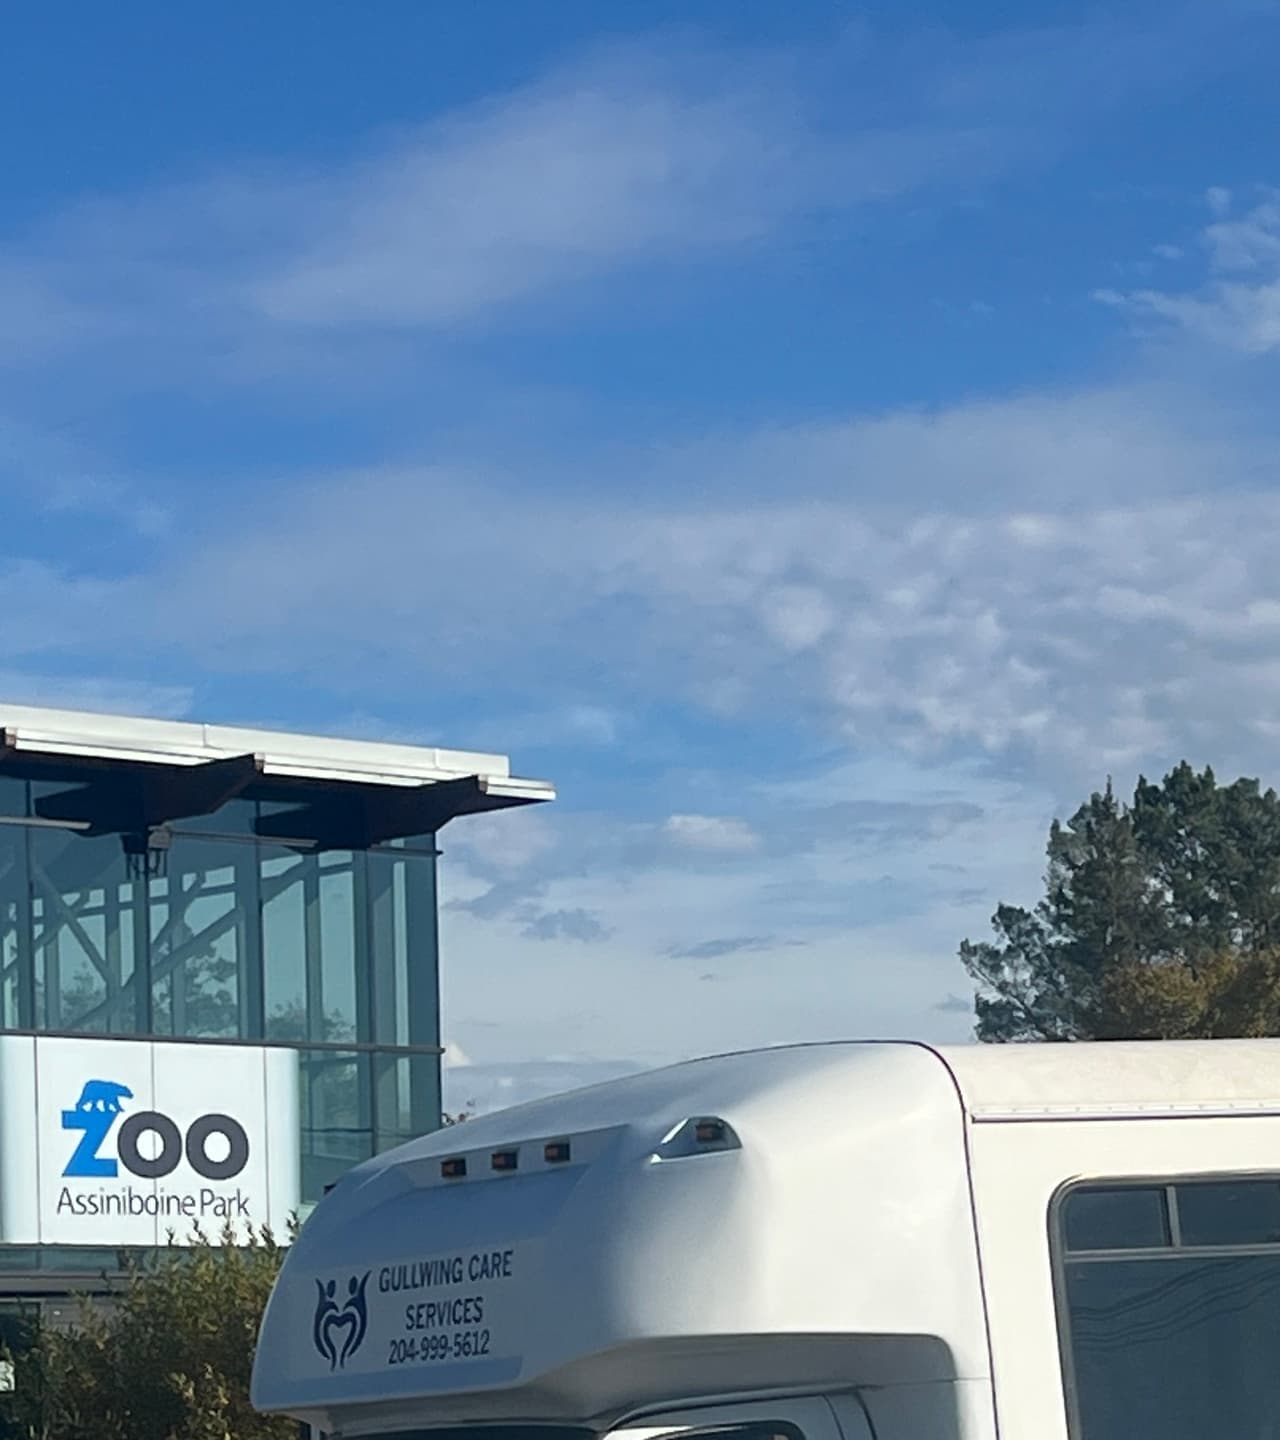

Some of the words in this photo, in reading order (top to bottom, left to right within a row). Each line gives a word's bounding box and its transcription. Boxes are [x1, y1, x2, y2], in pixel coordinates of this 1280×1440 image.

[57, 1186, 196, 1216] Assiniboine
[200, 1188, 250, 1217] Park
[379, 1257, 464, 1293] GULLWING
[469, 1250, 514, 1282] CARE
[405, 1296, 483, 1331] SERVICES
[388, 1329, 490, 1365] 204-999-5612
